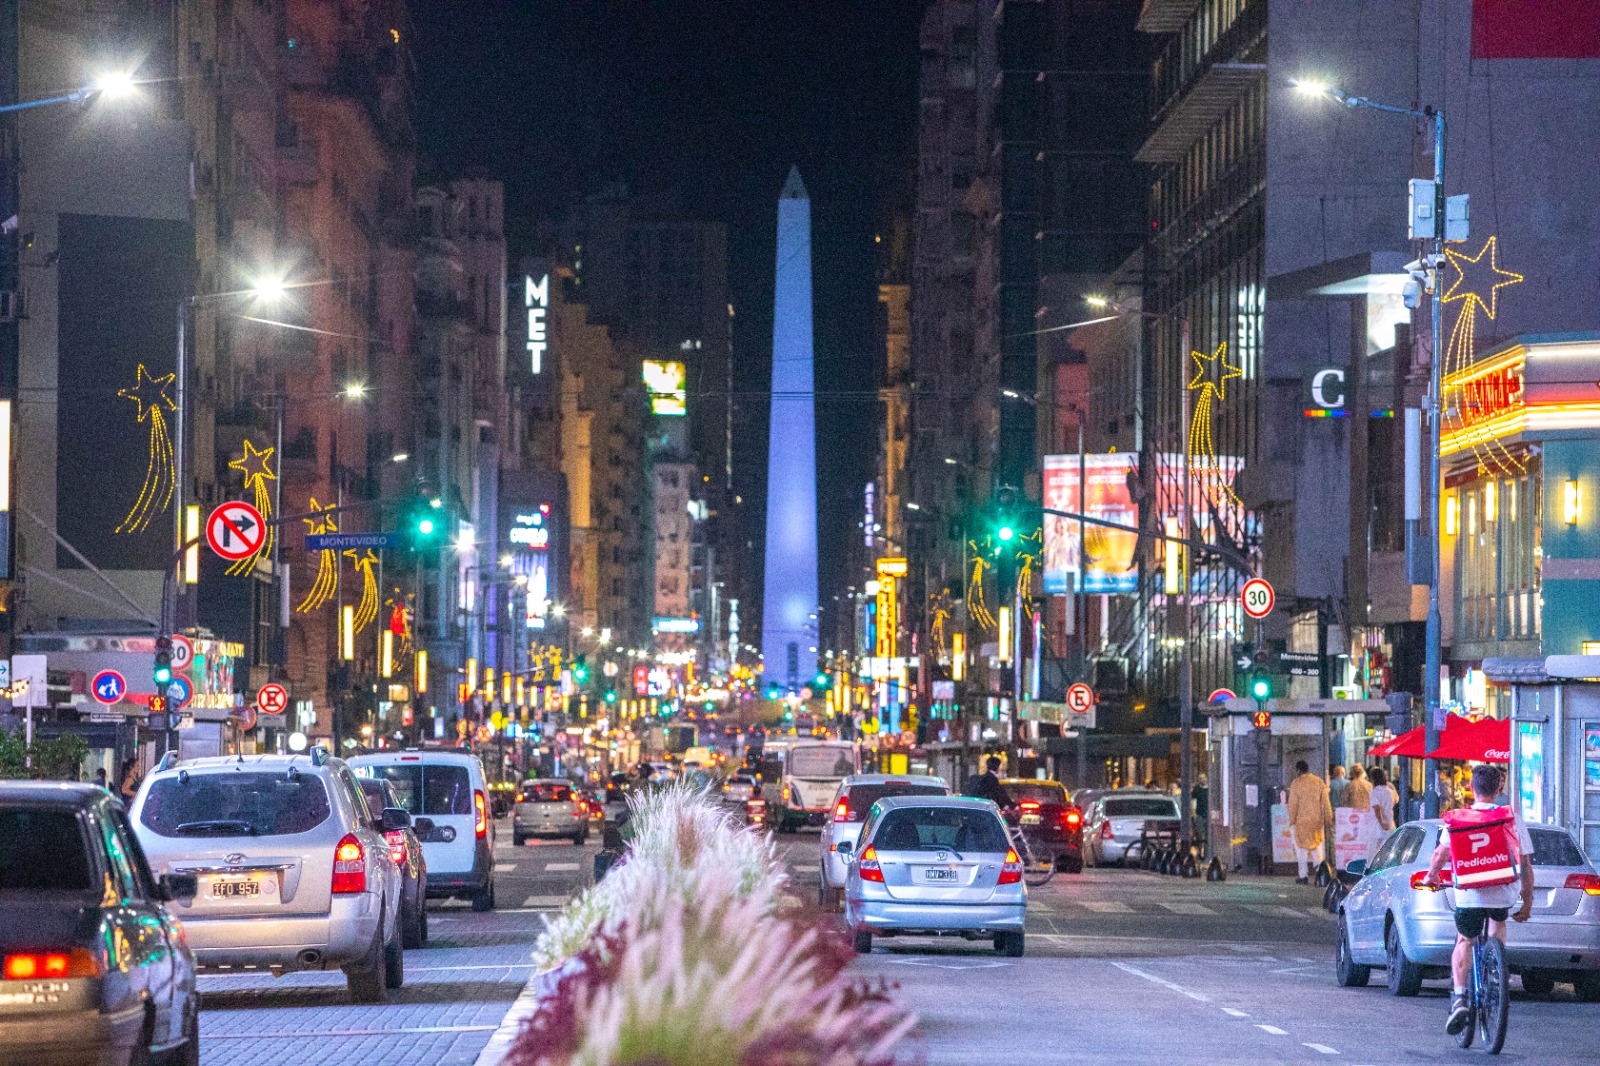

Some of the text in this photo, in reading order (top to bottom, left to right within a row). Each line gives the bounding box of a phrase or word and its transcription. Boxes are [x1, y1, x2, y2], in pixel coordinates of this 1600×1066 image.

[525, 273, 549, 375] MET
[1311, 369, 1345, 407] C
[320, 536, 388, 547] MONTEVIDEO
[1248, 590, 1267, 606] 30
[1456, 853, 1509, 869] PedidosYa
[238, 882, 258, 896] 957
